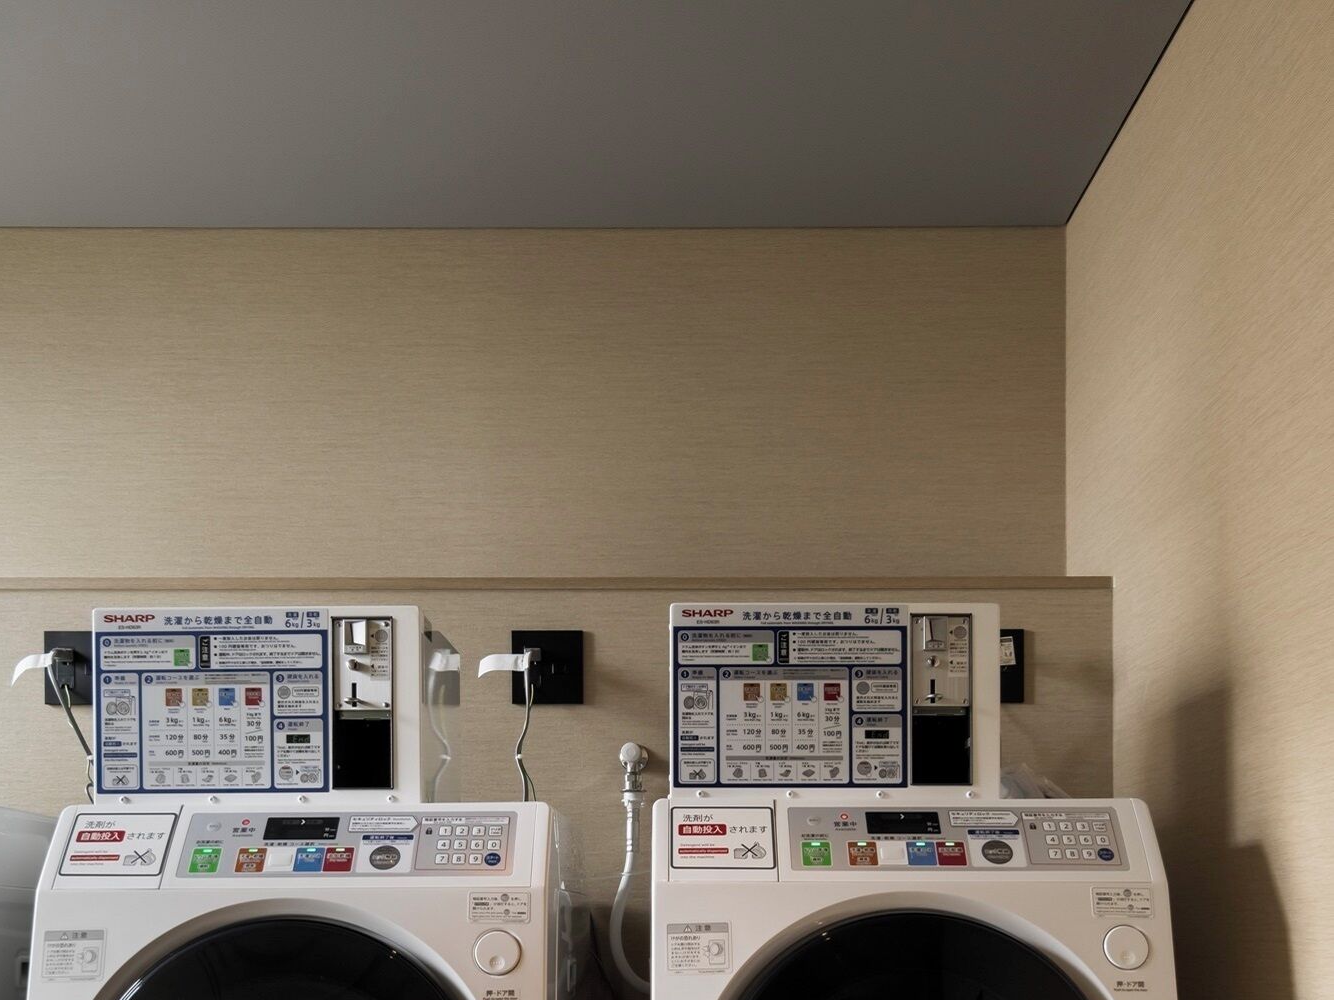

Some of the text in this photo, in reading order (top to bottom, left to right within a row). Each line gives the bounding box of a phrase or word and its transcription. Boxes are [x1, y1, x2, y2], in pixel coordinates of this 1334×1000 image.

[681, 609, 734, 618] SHARP
[742, 611, 853, 621] 洗濯から乾燥まで全自動
[104, 614, 155, 623] SHARP
[164, 616, 274, 626] 洗濯から乾燥まで全自動
[682, 814, 714, 822] 洗剤が
[84, 820, 116, 829] 洗剤が
[682, 825, 768, 834] 自動投入 されます
[80, 831, 166, 841] 自動投入 されます
